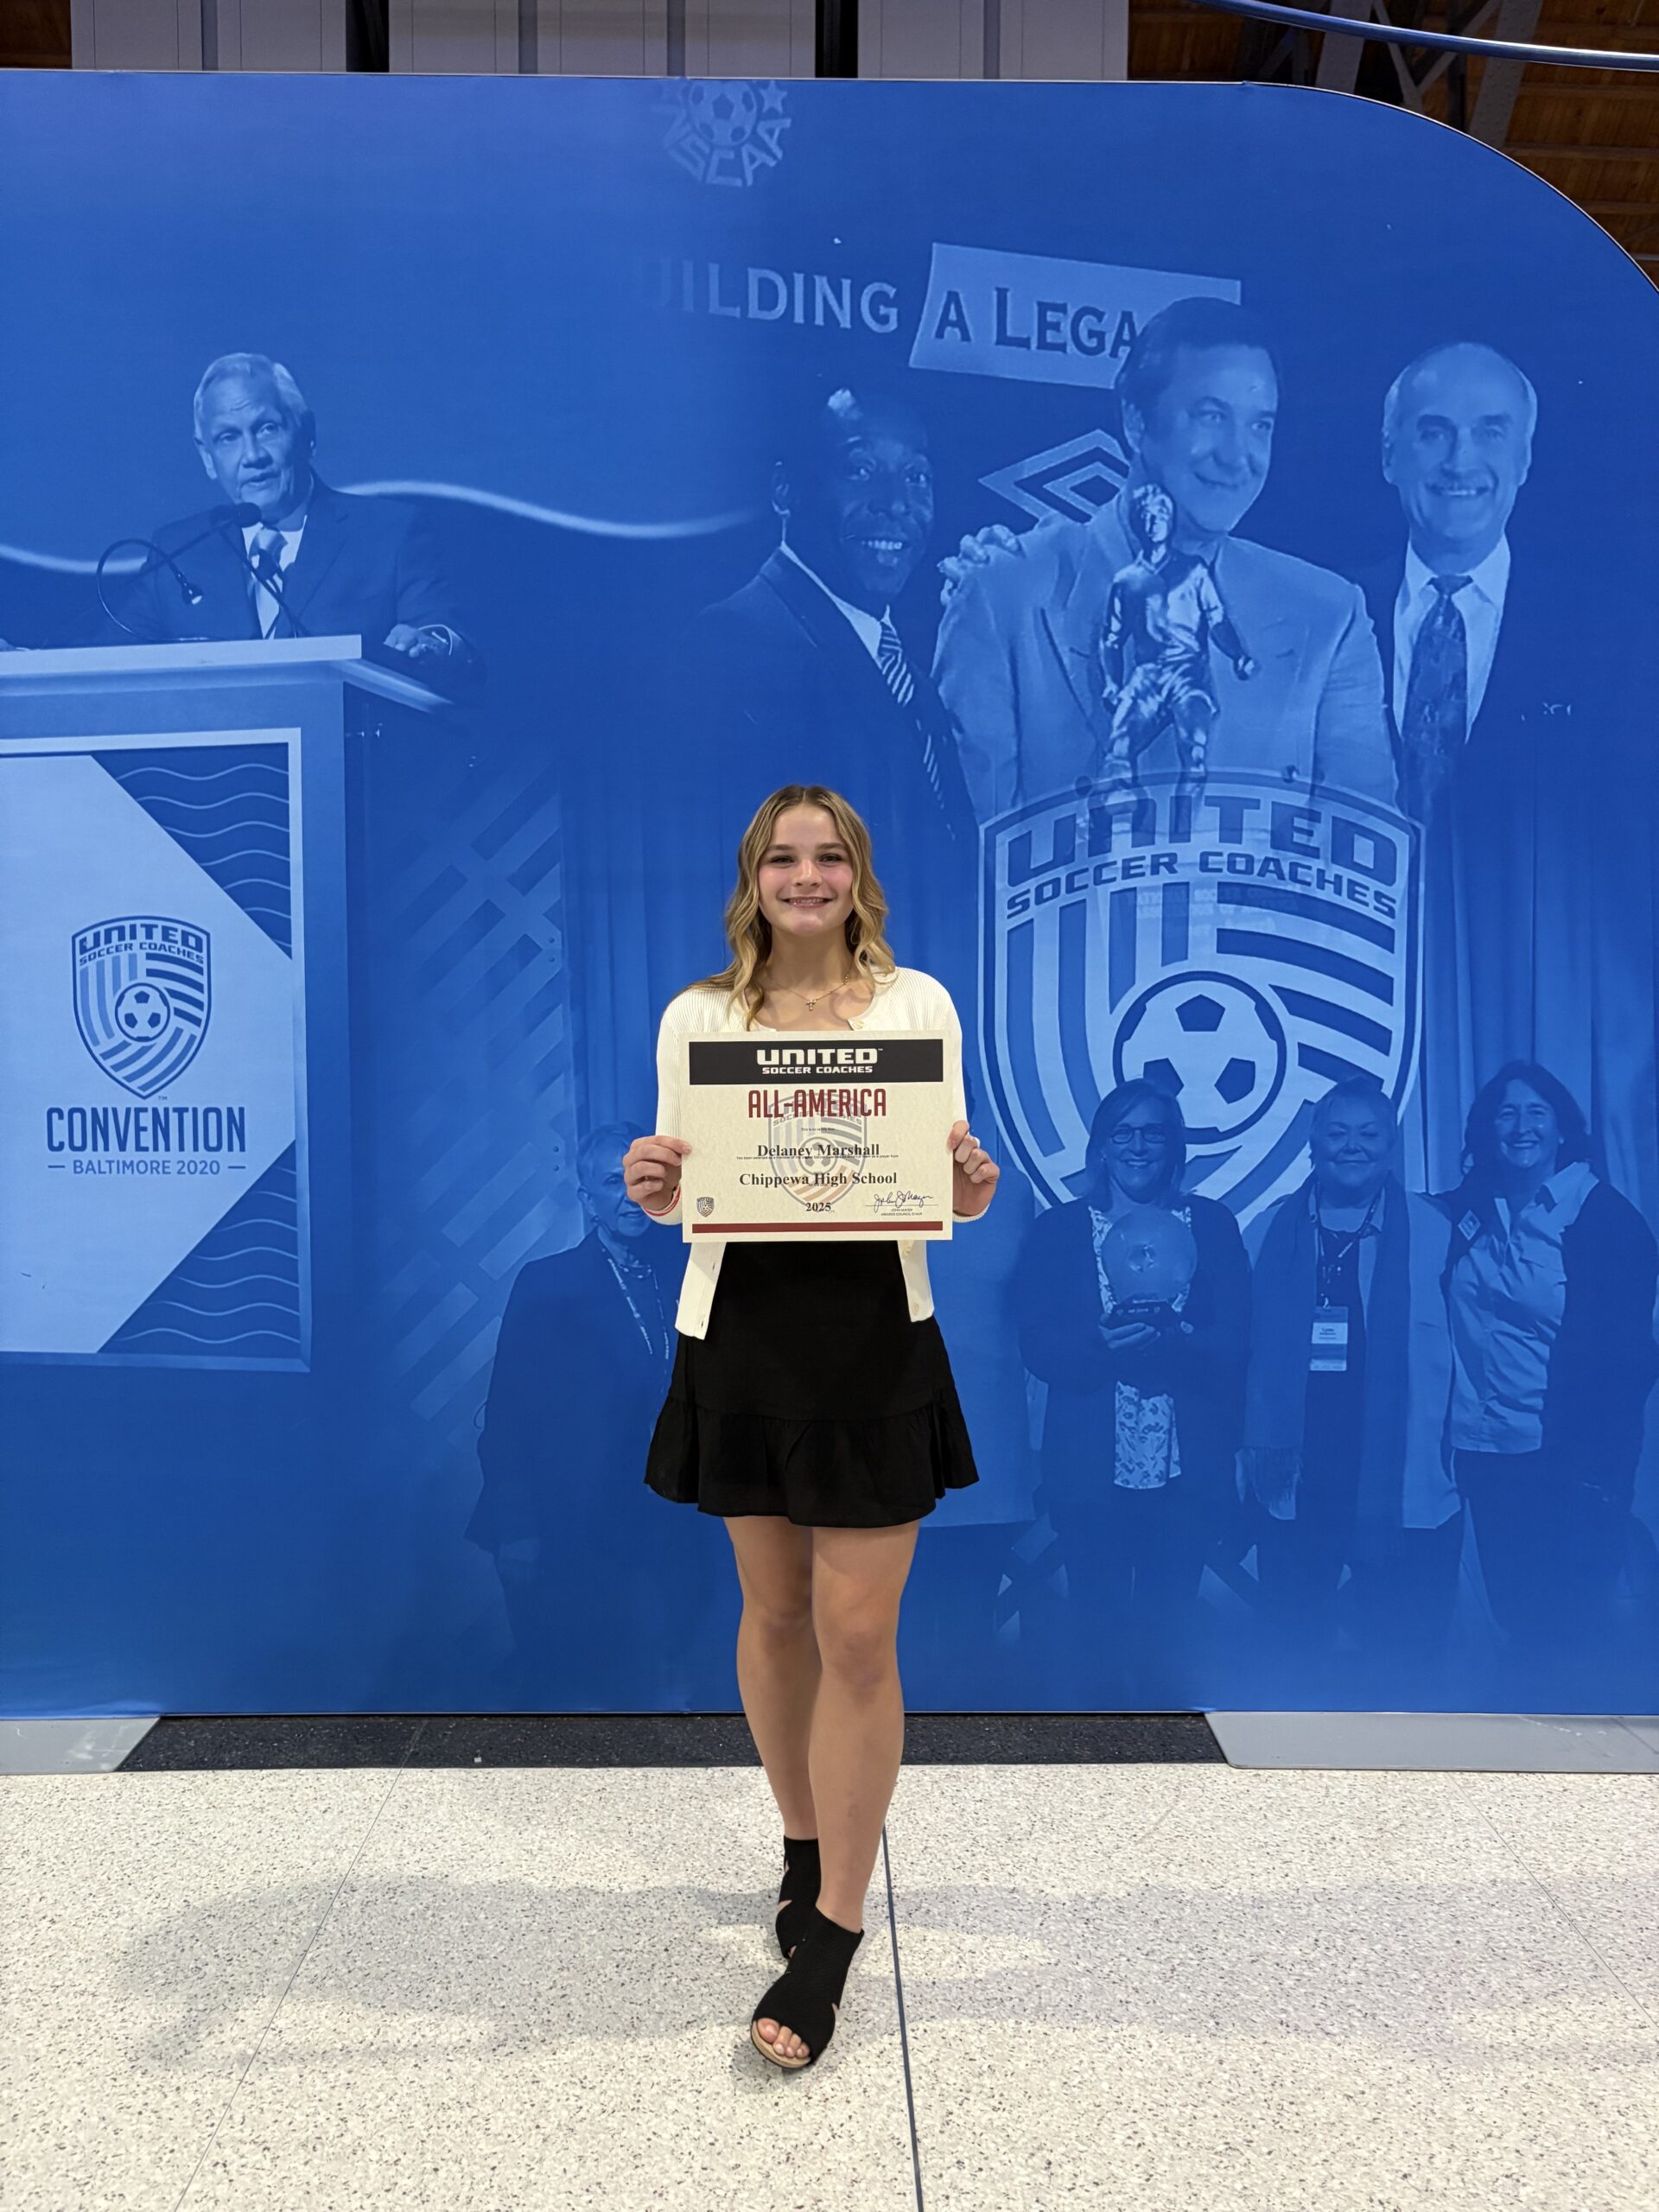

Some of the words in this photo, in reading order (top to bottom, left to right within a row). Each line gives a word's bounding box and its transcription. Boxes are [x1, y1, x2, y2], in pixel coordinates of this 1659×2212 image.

[632, 254, 899, 334] UILDING
[934, 290, 972, 343] A
[995, 287, 1137, 359] LEGA
[1007, 794, 1398, 887] UNITED
[1007, 852, 1179, 919] SOCCER
[1198, 851, 1397, 919] COACHES
[79, 923, 203, 956] UNITED
[79, 943, 133, 966] SOCCER
[139, 942, 204, 964] COACHES
[756, 1048, 878, 1065] UNITED
[762, 1066, 811, 1075] SOCCER
[816, 1065, 873, 1074] COACHES
[748, 1088, 887, 1118] ALL-AMERICA
[46, 1106, 246, 1153] CONVENTION
[758, 1145, 813, 1159] Delaney
[817, 1143, 880, 1157] Marshall
[73, 1160, 171, 1175] BALTIMORE
[176, 1160, 220, 1175] 2020
[739, 1173, 810, 1188] Chippewa
[815, 1173, 847, 1187] High
[852, 1172, 897, 1185] School
[805, 1202, 831, 1211] 2025
